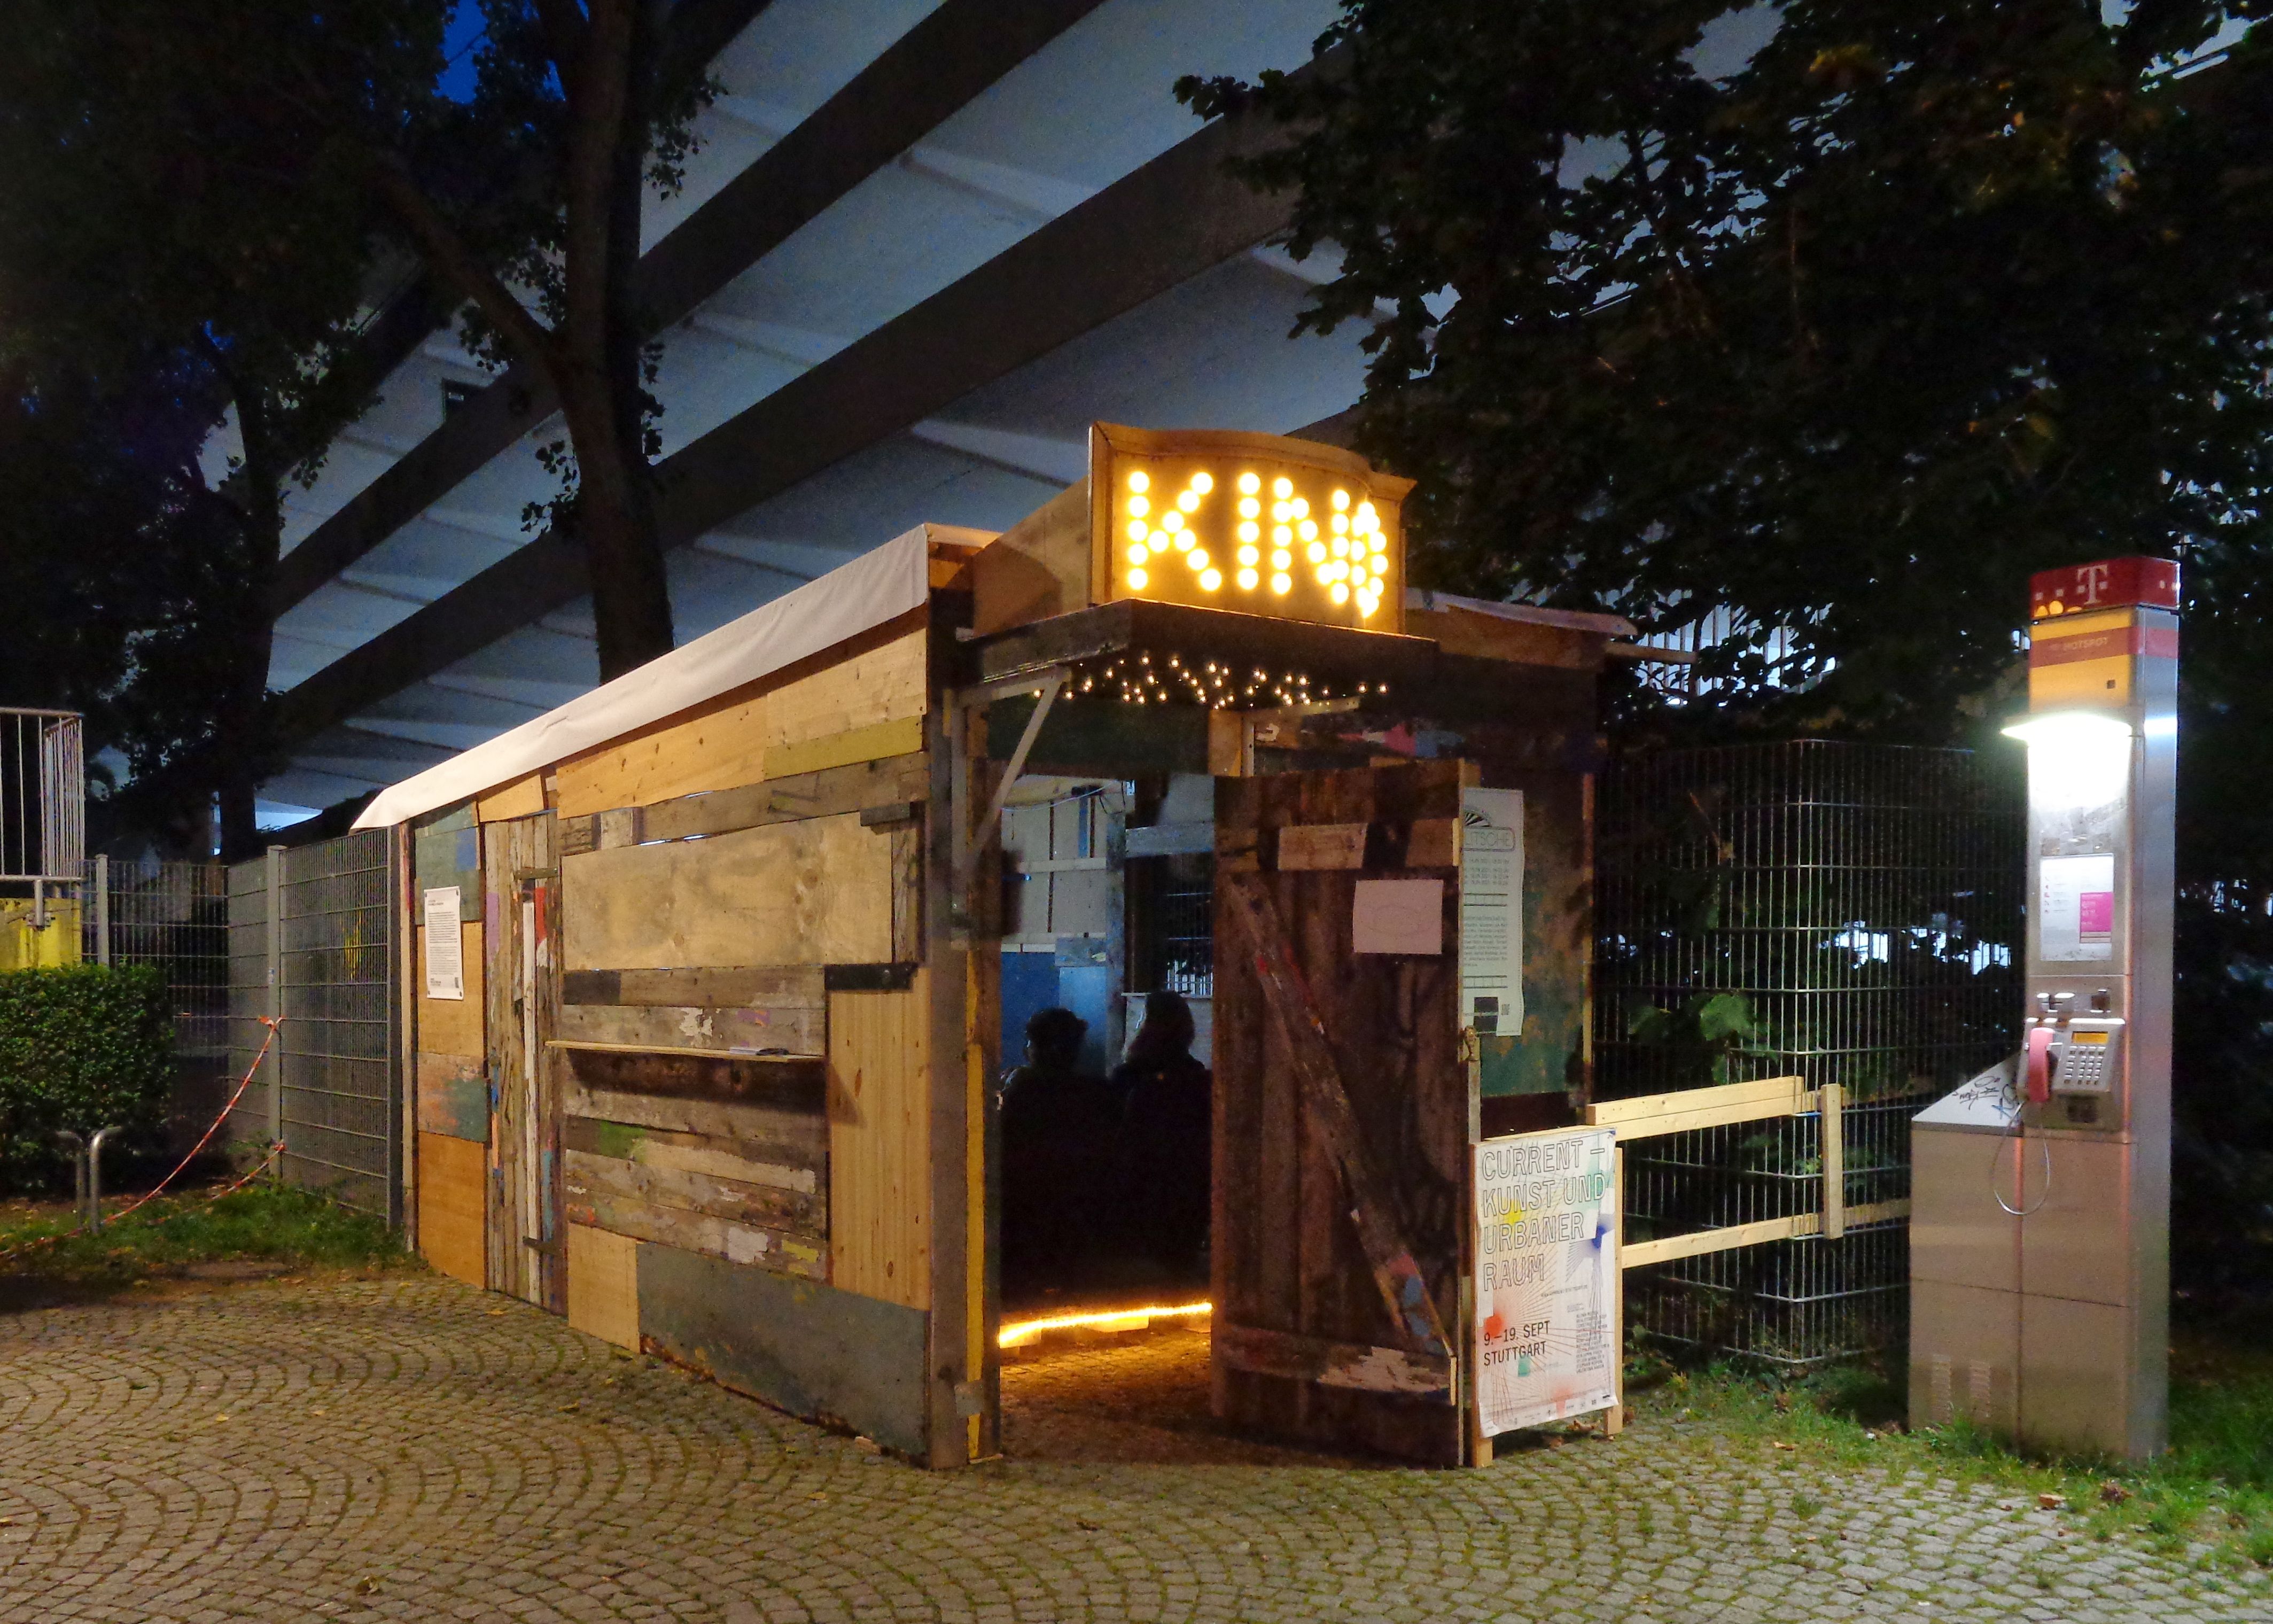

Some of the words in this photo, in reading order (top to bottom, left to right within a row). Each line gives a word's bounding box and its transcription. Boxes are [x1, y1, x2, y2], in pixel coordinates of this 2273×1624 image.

[1127, 470, 1389, 618] KINO
[2077, 563, 2108, 605] T
[1482, 1140, 1583, 1181] CURRENT
[1483, 1179, 1555, 1218] KUNST
[1563, 1173, 1606, 1206] UND
[1484, 1211, 1584, 1254] URBANER
[1483, 1253, 1545, 1292] RAUM
[1523, 1320, 1550, 1338] SEPT
[1484, 1341, 1546, 1366] STUTTGART
